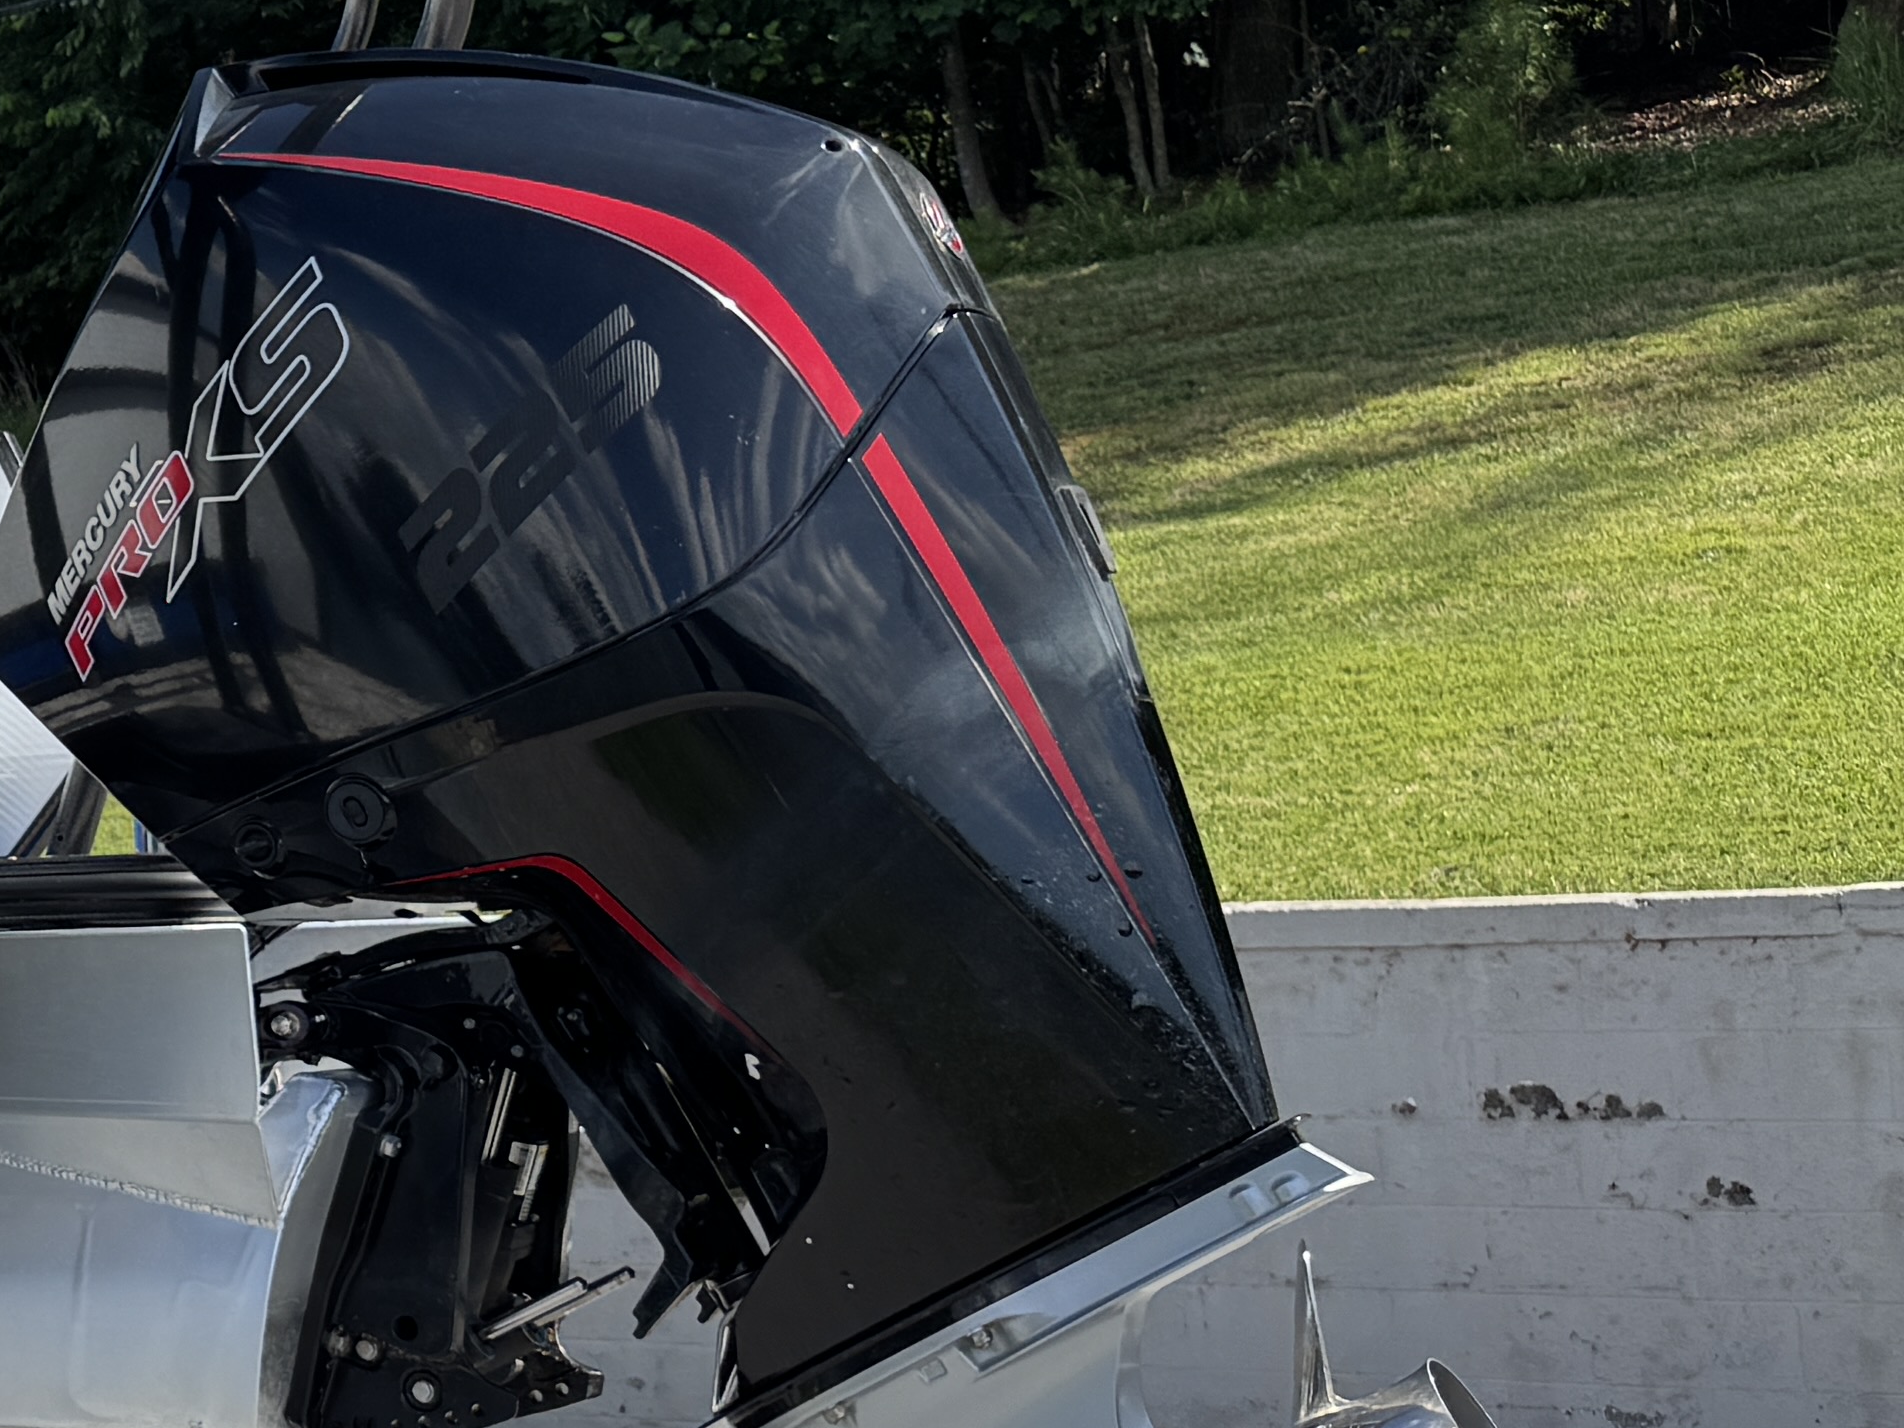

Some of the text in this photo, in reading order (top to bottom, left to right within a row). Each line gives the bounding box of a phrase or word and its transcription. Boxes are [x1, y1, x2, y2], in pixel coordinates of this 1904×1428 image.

[47, 442, 141, 625] MERCURY
[64, 255, 352, 684] PRO XS
[396, 302, 662, 616] 225
